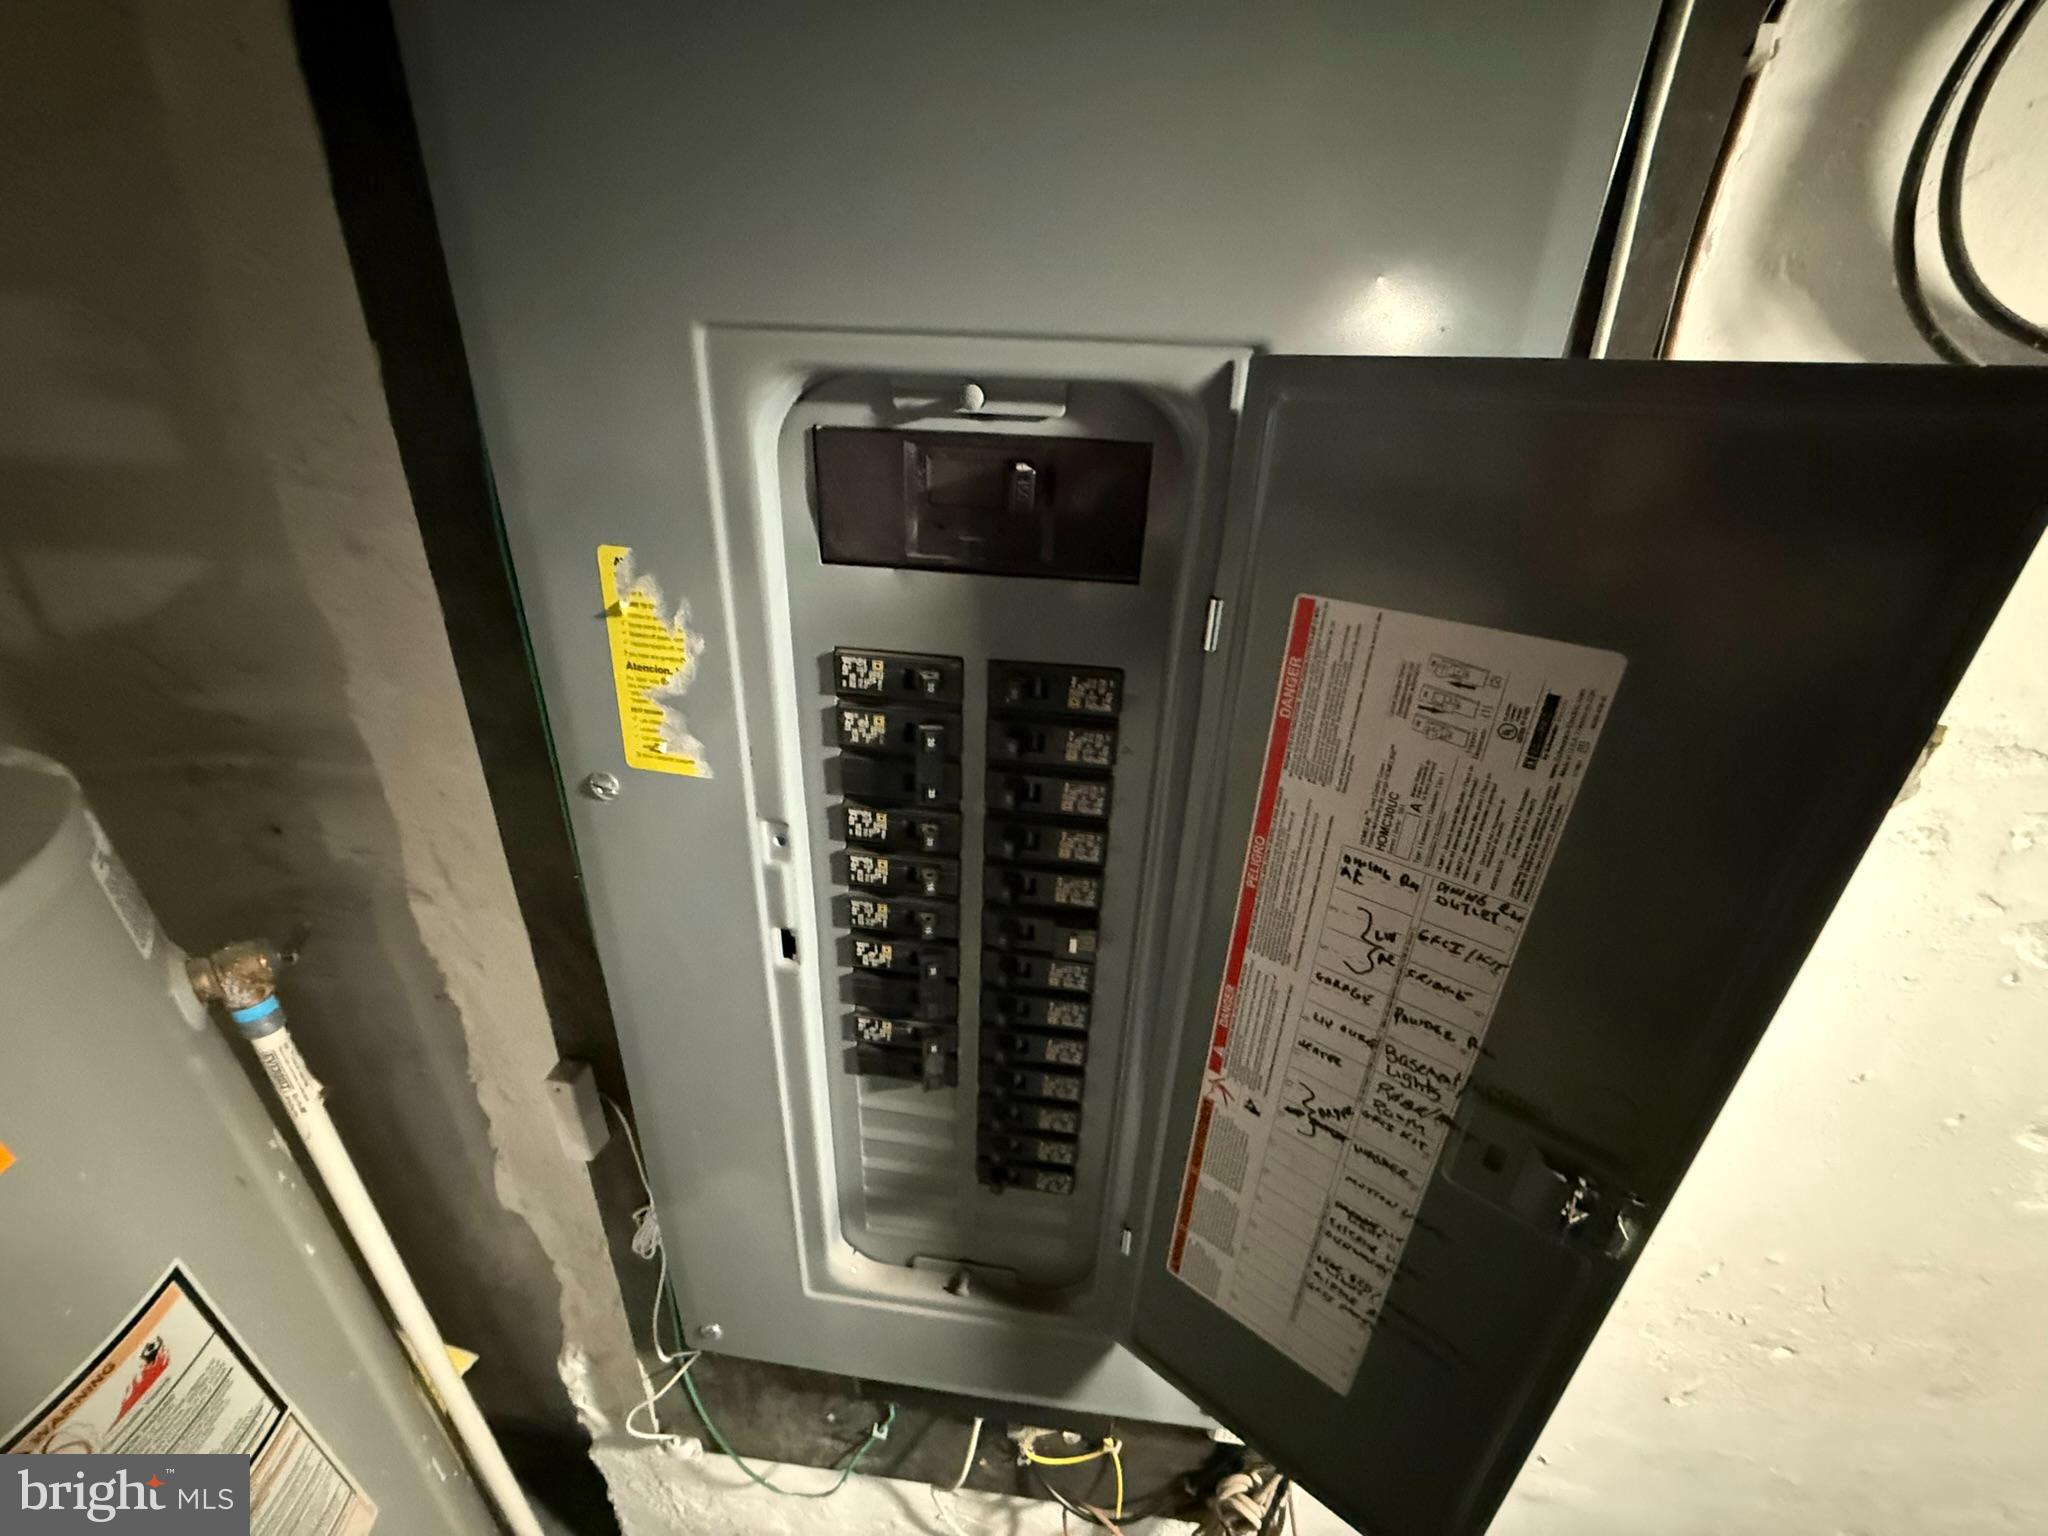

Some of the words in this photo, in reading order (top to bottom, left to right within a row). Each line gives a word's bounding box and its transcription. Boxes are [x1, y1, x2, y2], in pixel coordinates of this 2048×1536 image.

[1278, 656, 1302, 719] DANGER
[1373, 790, 1400, 852] HOMC30UC
[1408, 801, 1423, 813] A
[1245, 835, 1267, 889] PELIGRO
[30, 1362, 117, 1444] WARNING
